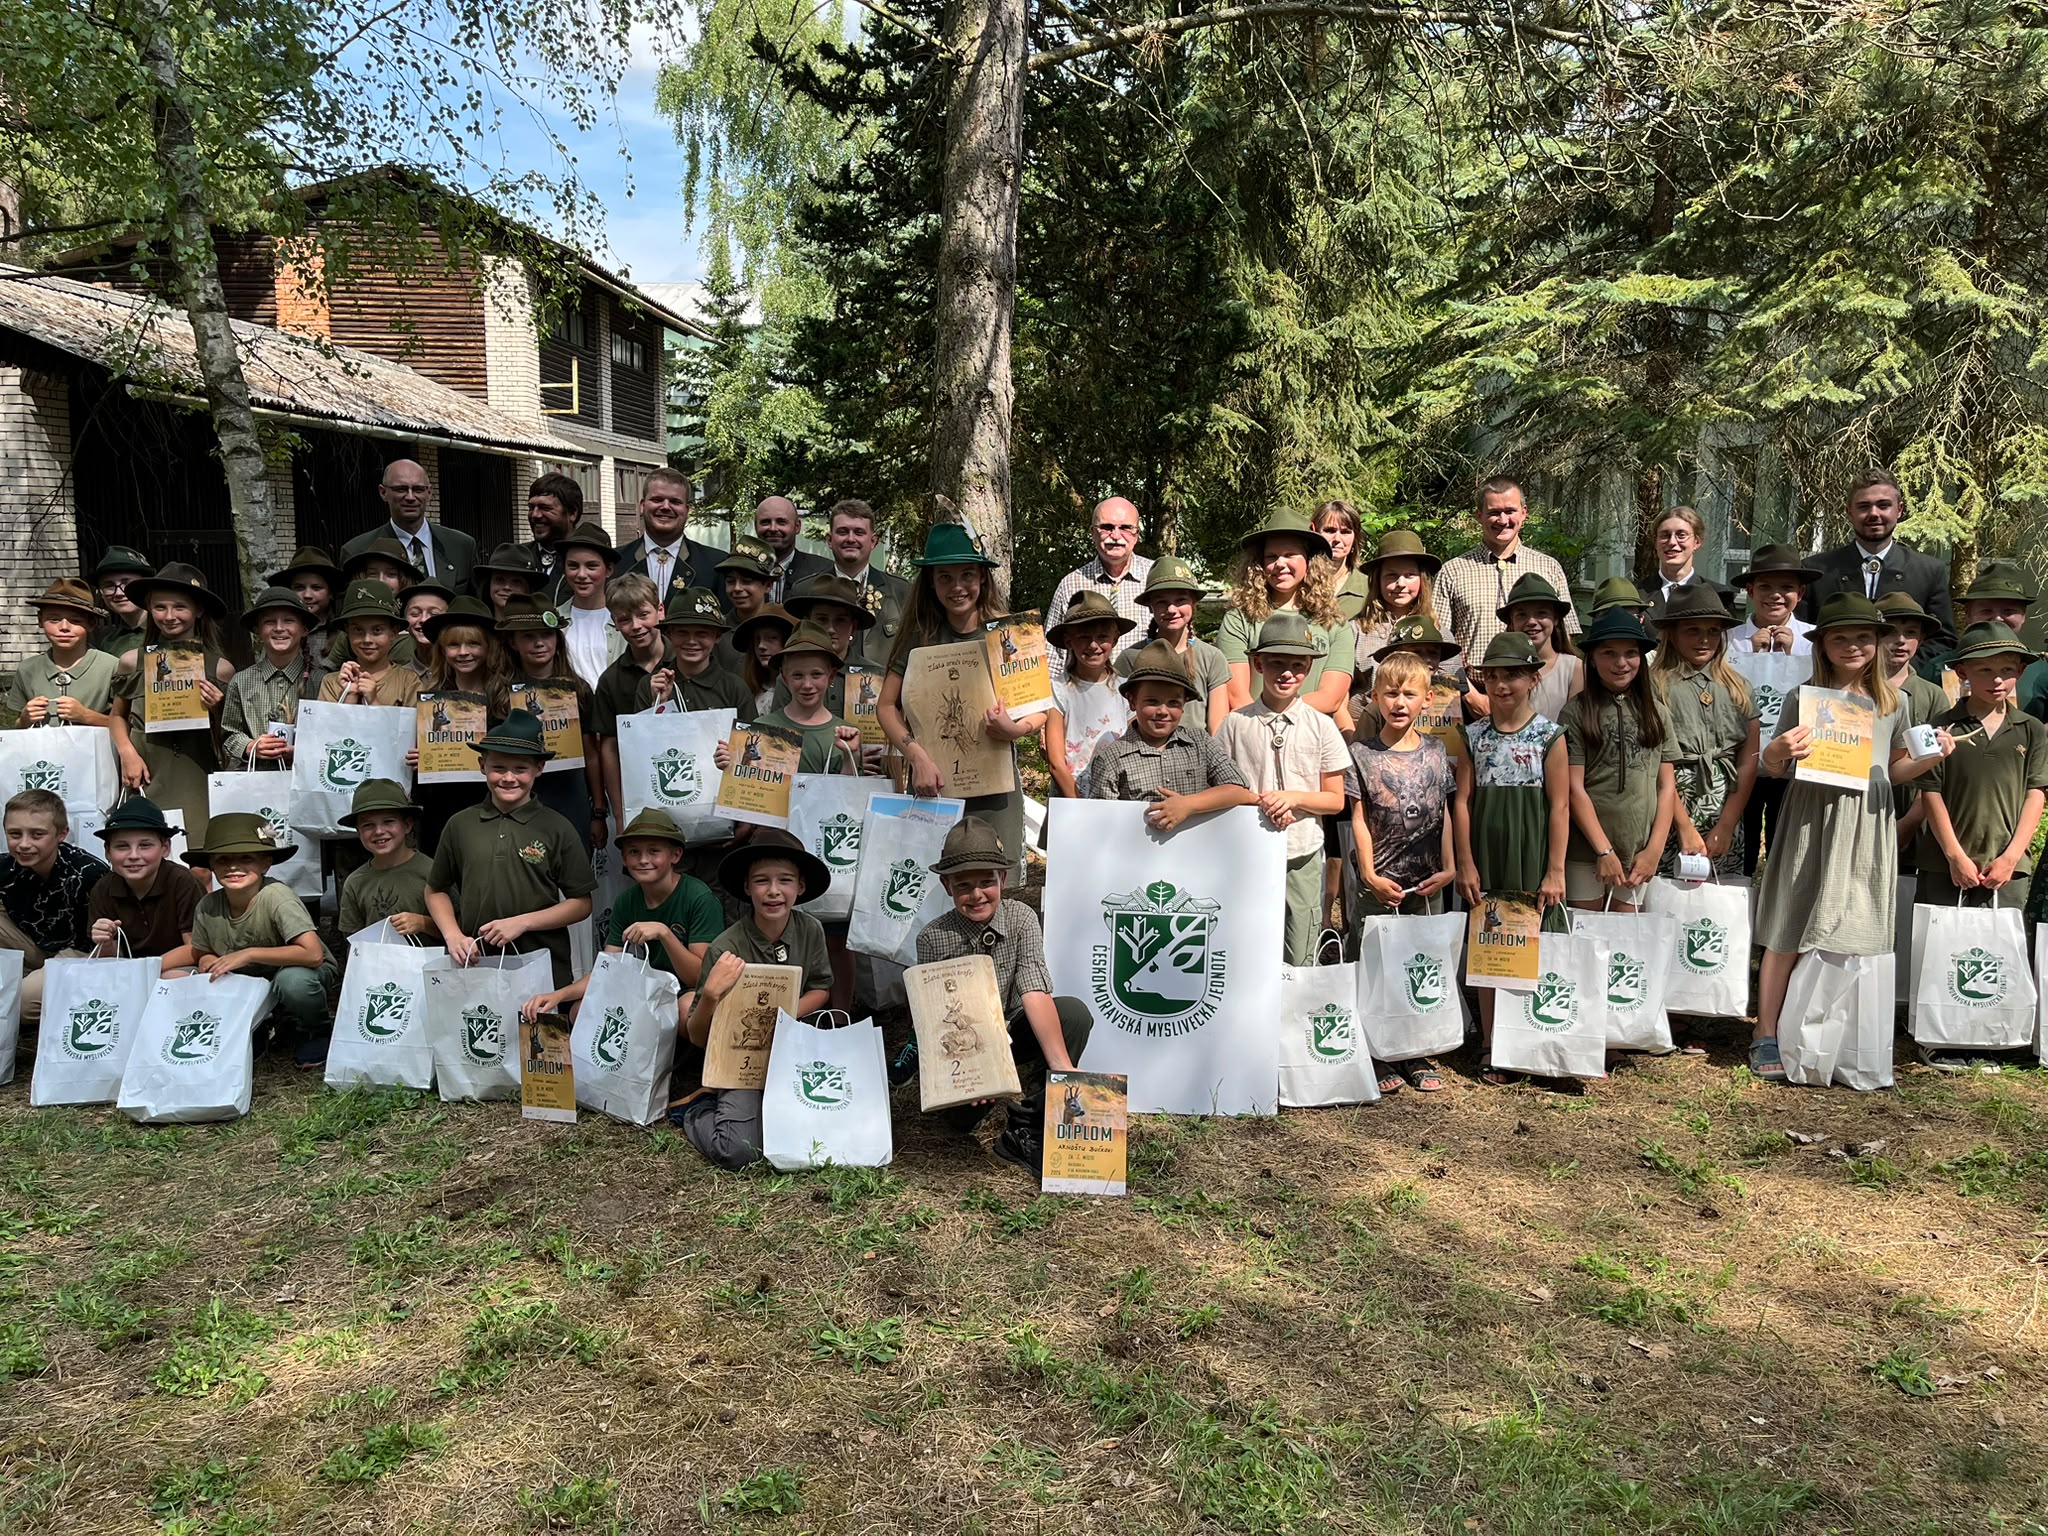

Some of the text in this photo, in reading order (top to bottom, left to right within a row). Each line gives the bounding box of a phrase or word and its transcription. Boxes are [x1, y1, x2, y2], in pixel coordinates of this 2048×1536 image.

[1000, 656, 1039, 677] DIPLOM
[153, 679, 194, 694] DIPLOM
[854, 703, 874, 715] DIP
[545, 718, 569, 732] LOM
[1414, 716, 1452, 727] IPLOM
[428, 731, 475, 743] DIPLOM
[1811, 727, 1859, 746] DIPLOM
[733, 765, 784, 784] DIPLOM
[952, 759, 965, 775] 1.
[1478, 932, 1526, 947] DIPLOM
[1091, 944, 1226, 1037] ČESKOMORAVSKÁ MYSLIVECKÁ JEDNOTA
[527, 1060, 564, 1075] DIPLOM
[951, 1059, 966, 1076] 2.
[1057, 1124, 1113, 1142] DIPLOM
